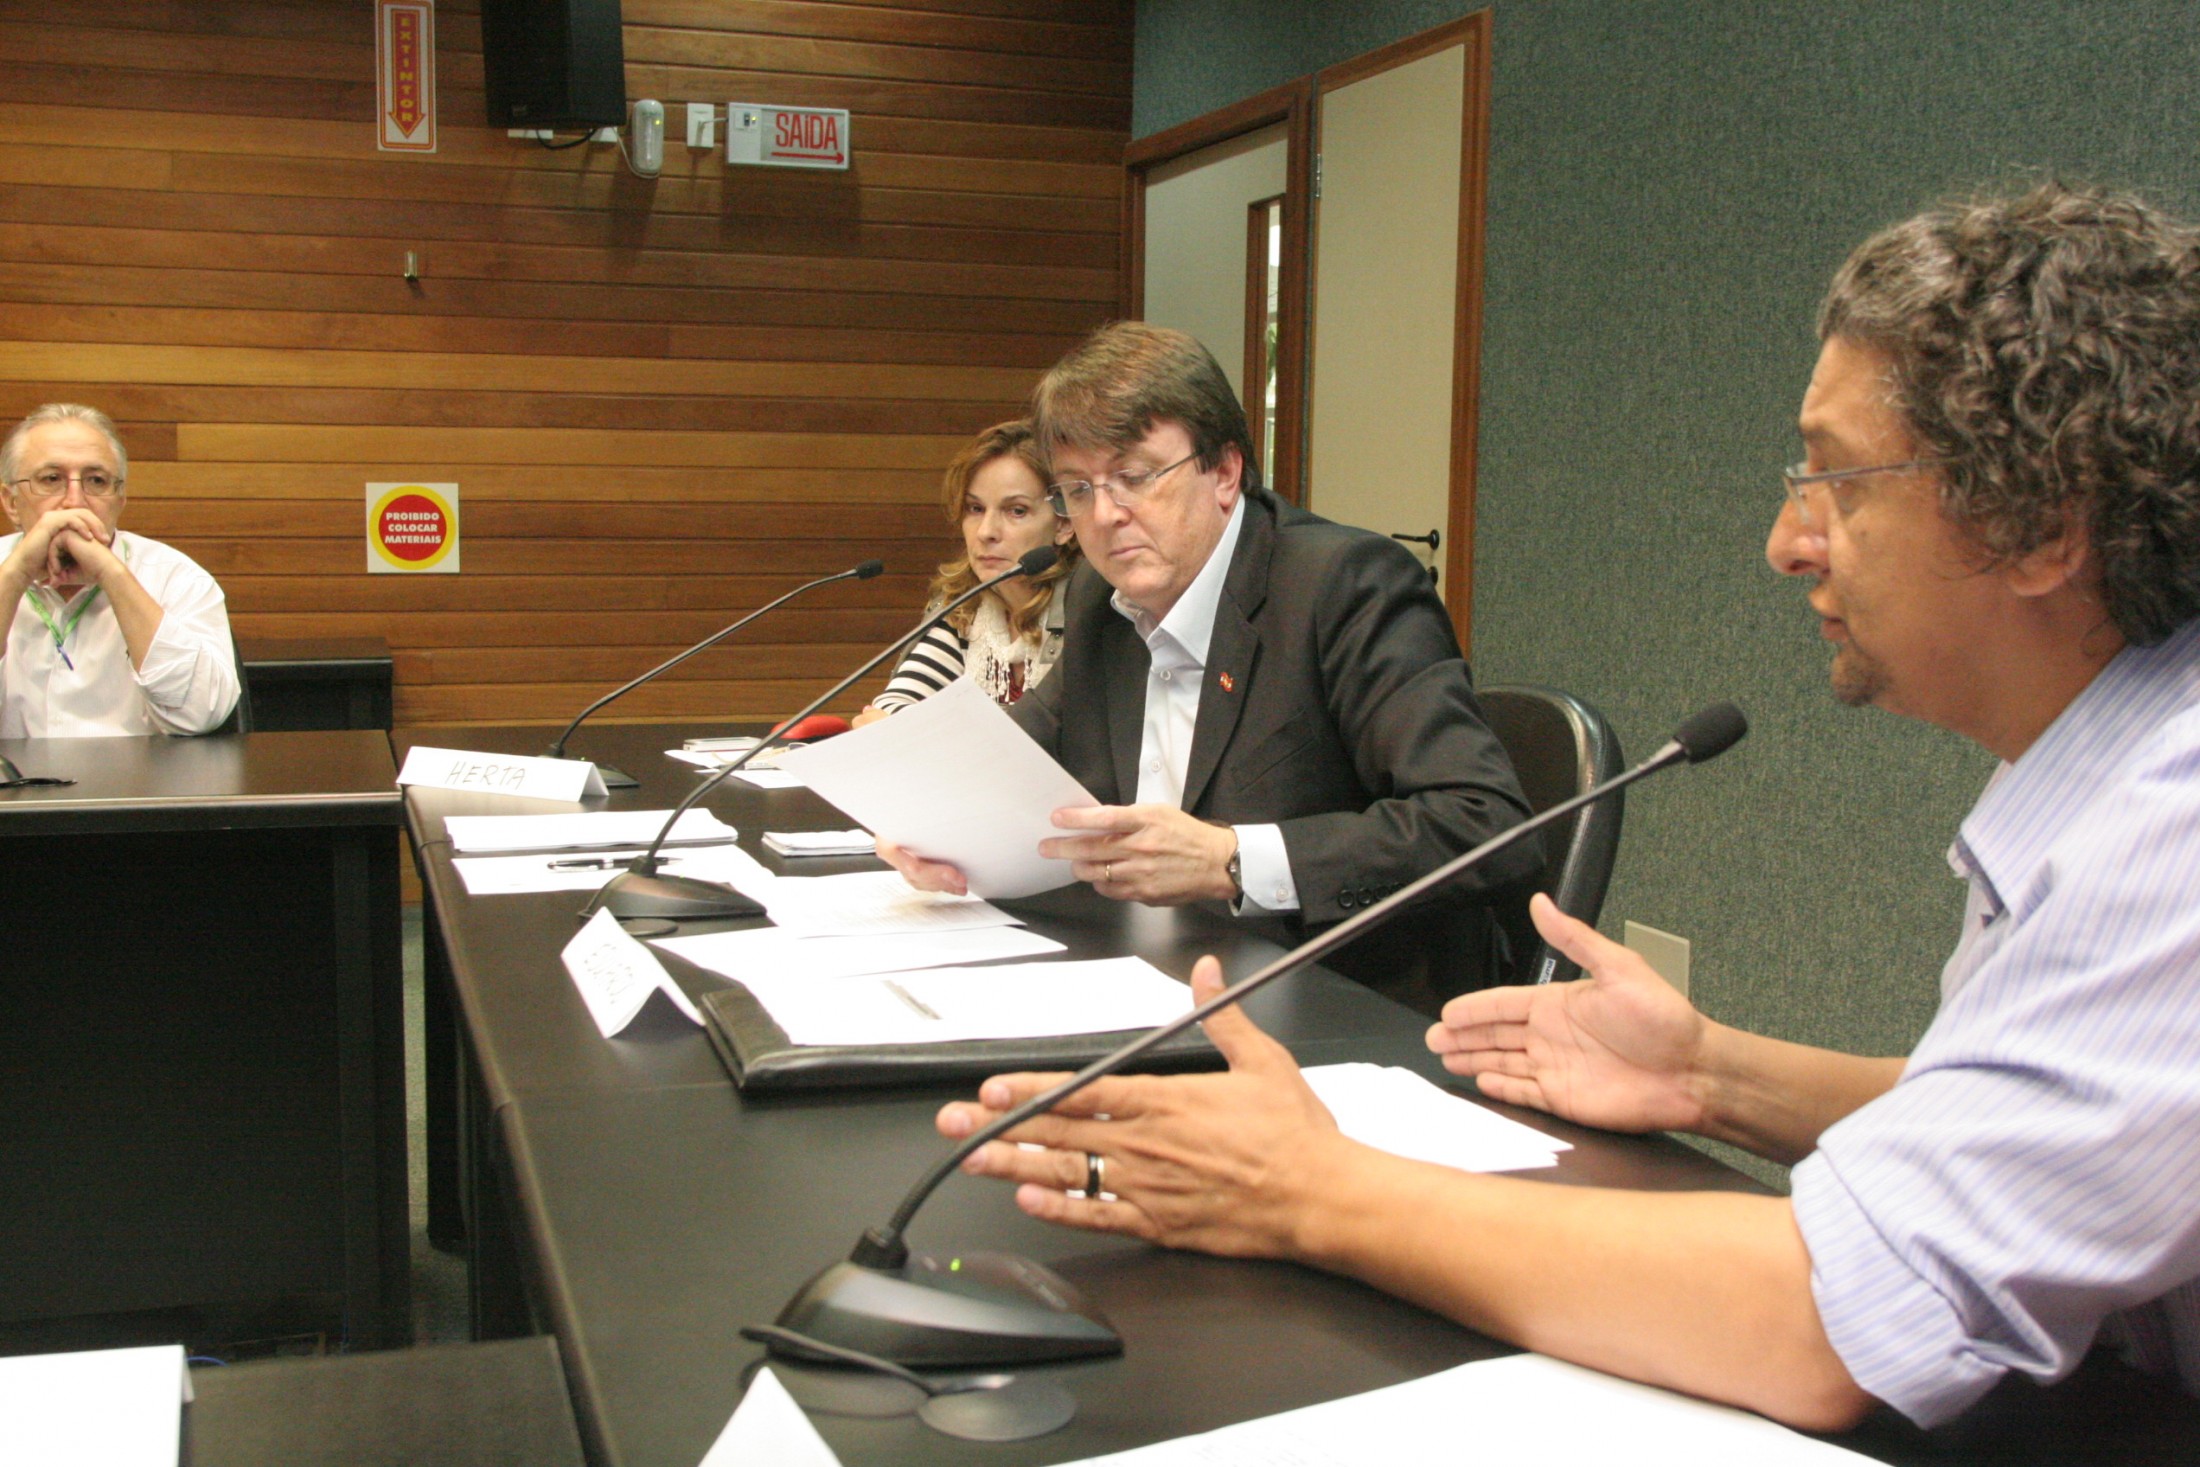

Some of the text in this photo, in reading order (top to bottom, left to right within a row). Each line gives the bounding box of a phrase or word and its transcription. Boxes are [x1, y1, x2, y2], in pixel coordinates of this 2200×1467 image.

[400, 17, 414, 122] EXTINTOR
[385, 512, 440, 521] PROIBIDO
[388, 523, 438, 532] COLOCAR
[384, 535, 442, 544] MATERIAIS
[444, 760, 526, 790] HERTA
